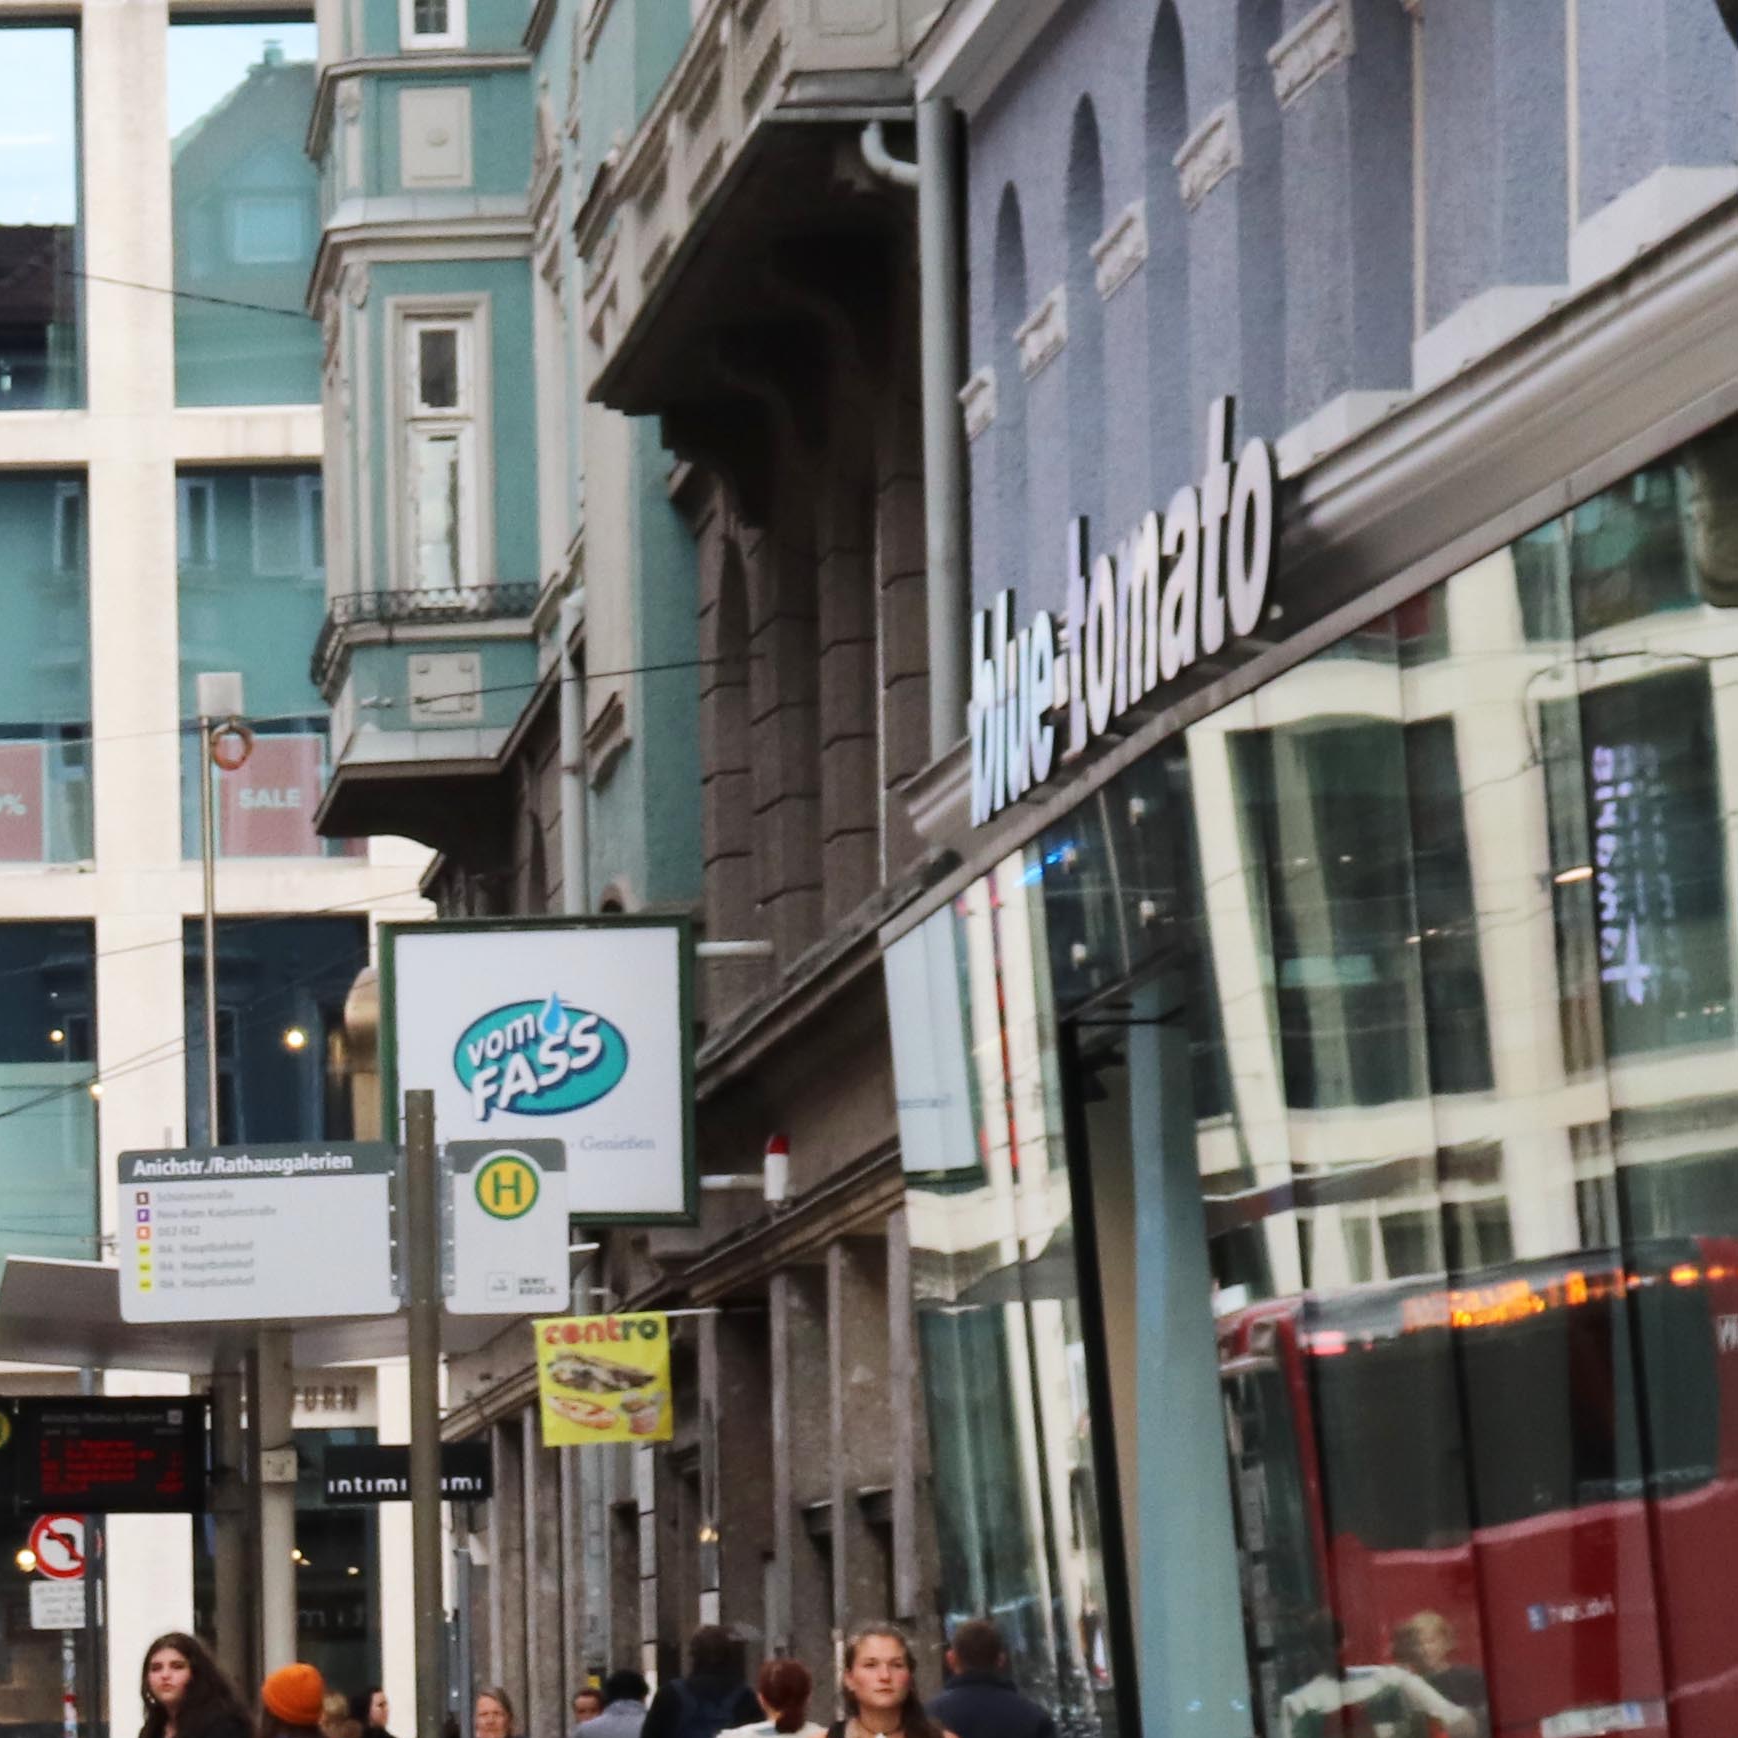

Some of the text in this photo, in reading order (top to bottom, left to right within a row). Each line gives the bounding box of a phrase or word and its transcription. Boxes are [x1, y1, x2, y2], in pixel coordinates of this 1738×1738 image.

[970, 395, 1273, 828] blue tomato
[239, 787, 301, 809] SALE
[466, 1013, 537, 1068] vom
[470, 1014, 603, 1122] FASS
[132, 1152, 354, 1177] Anichstr./Rathausgalerien
[493, 1170, 523, 1206] H
[328, 1474, 482, 1494] intimiimi
